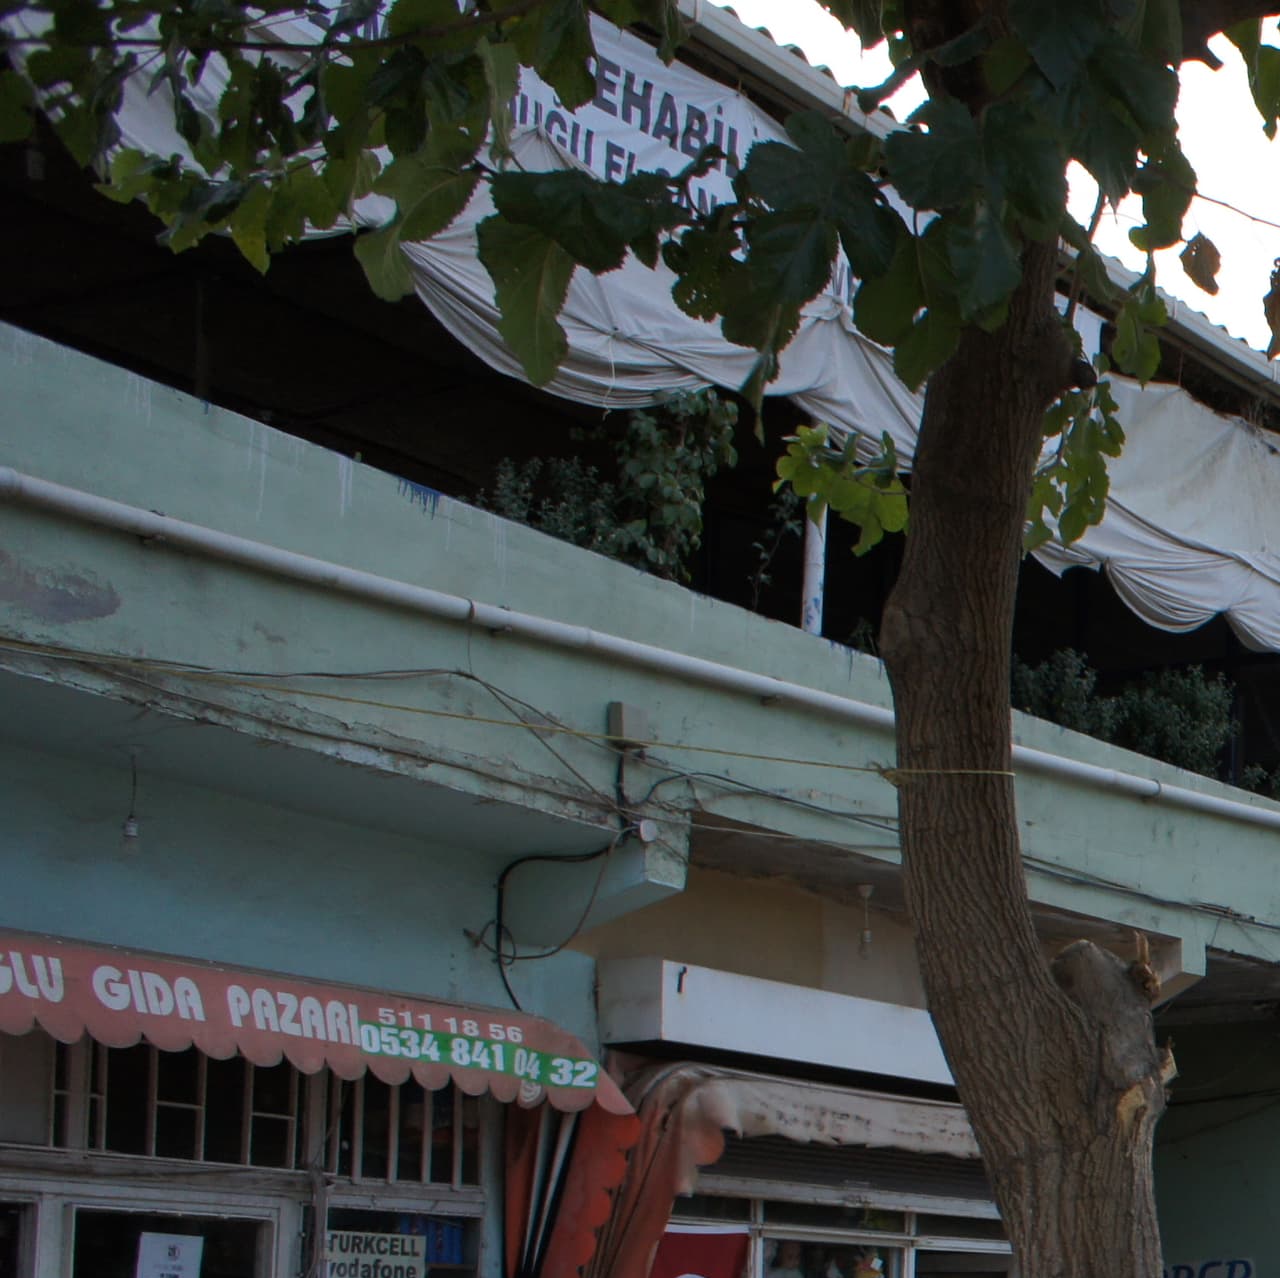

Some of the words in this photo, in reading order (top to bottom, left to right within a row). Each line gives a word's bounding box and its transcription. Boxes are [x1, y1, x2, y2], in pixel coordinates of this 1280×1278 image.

[92, 965, 206, 1021] GIDA
[226, 984, 361, 1047] PAZARI
[379, 1007, 432, 1031] 511
[444, 1017, 480, 1036] 18
[489, 1023, 523, 1043] 56
[361, 1024, 441, 1062] 0534
[451, 1038, 504, 1071] 841
[514, 1048, 541, 1080] 04
[550, 1058, 597, 1087] 32
[328, 1234, 420, 1257] TURKCELL
